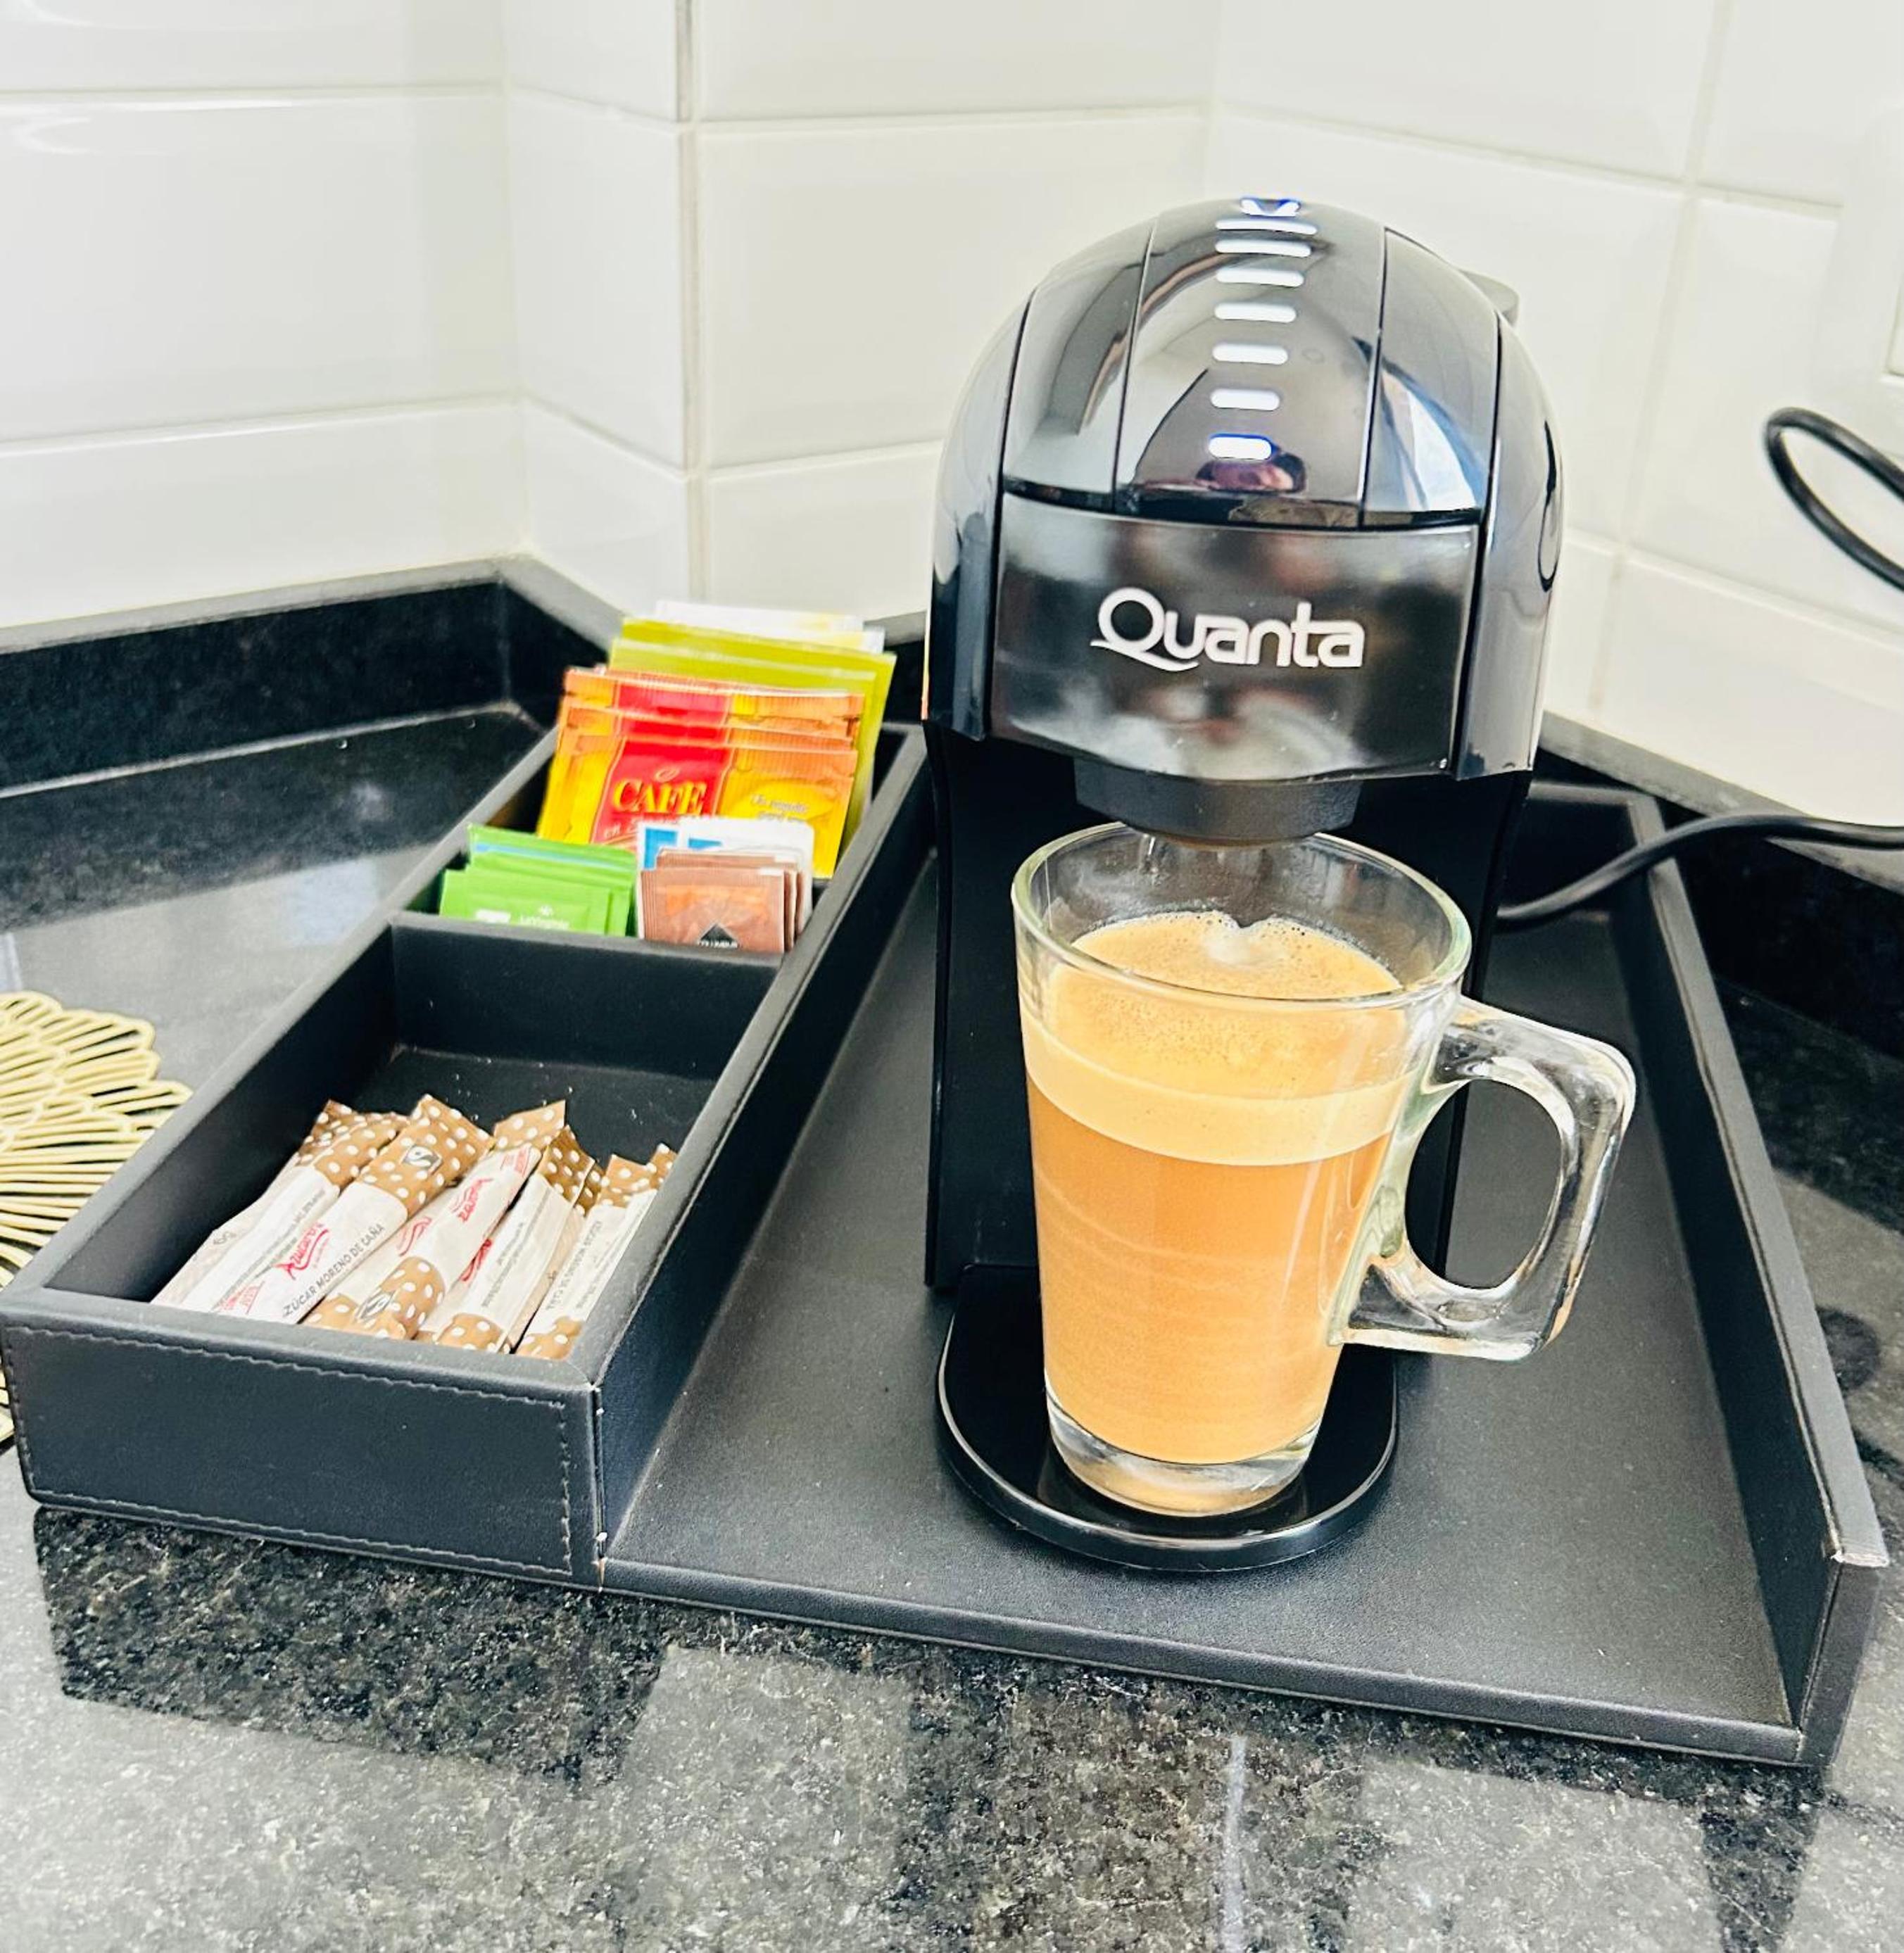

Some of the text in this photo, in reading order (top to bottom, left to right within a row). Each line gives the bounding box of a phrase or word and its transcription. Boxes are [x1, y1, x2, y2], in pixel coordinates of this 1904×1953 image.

[1090, 586, 1366, 671] Quanta
[315, 1253, 352, 1287] MORENO
[348, 1243, 364, 1257] DE
[361, 1222, 386, 1246] CAÑA
